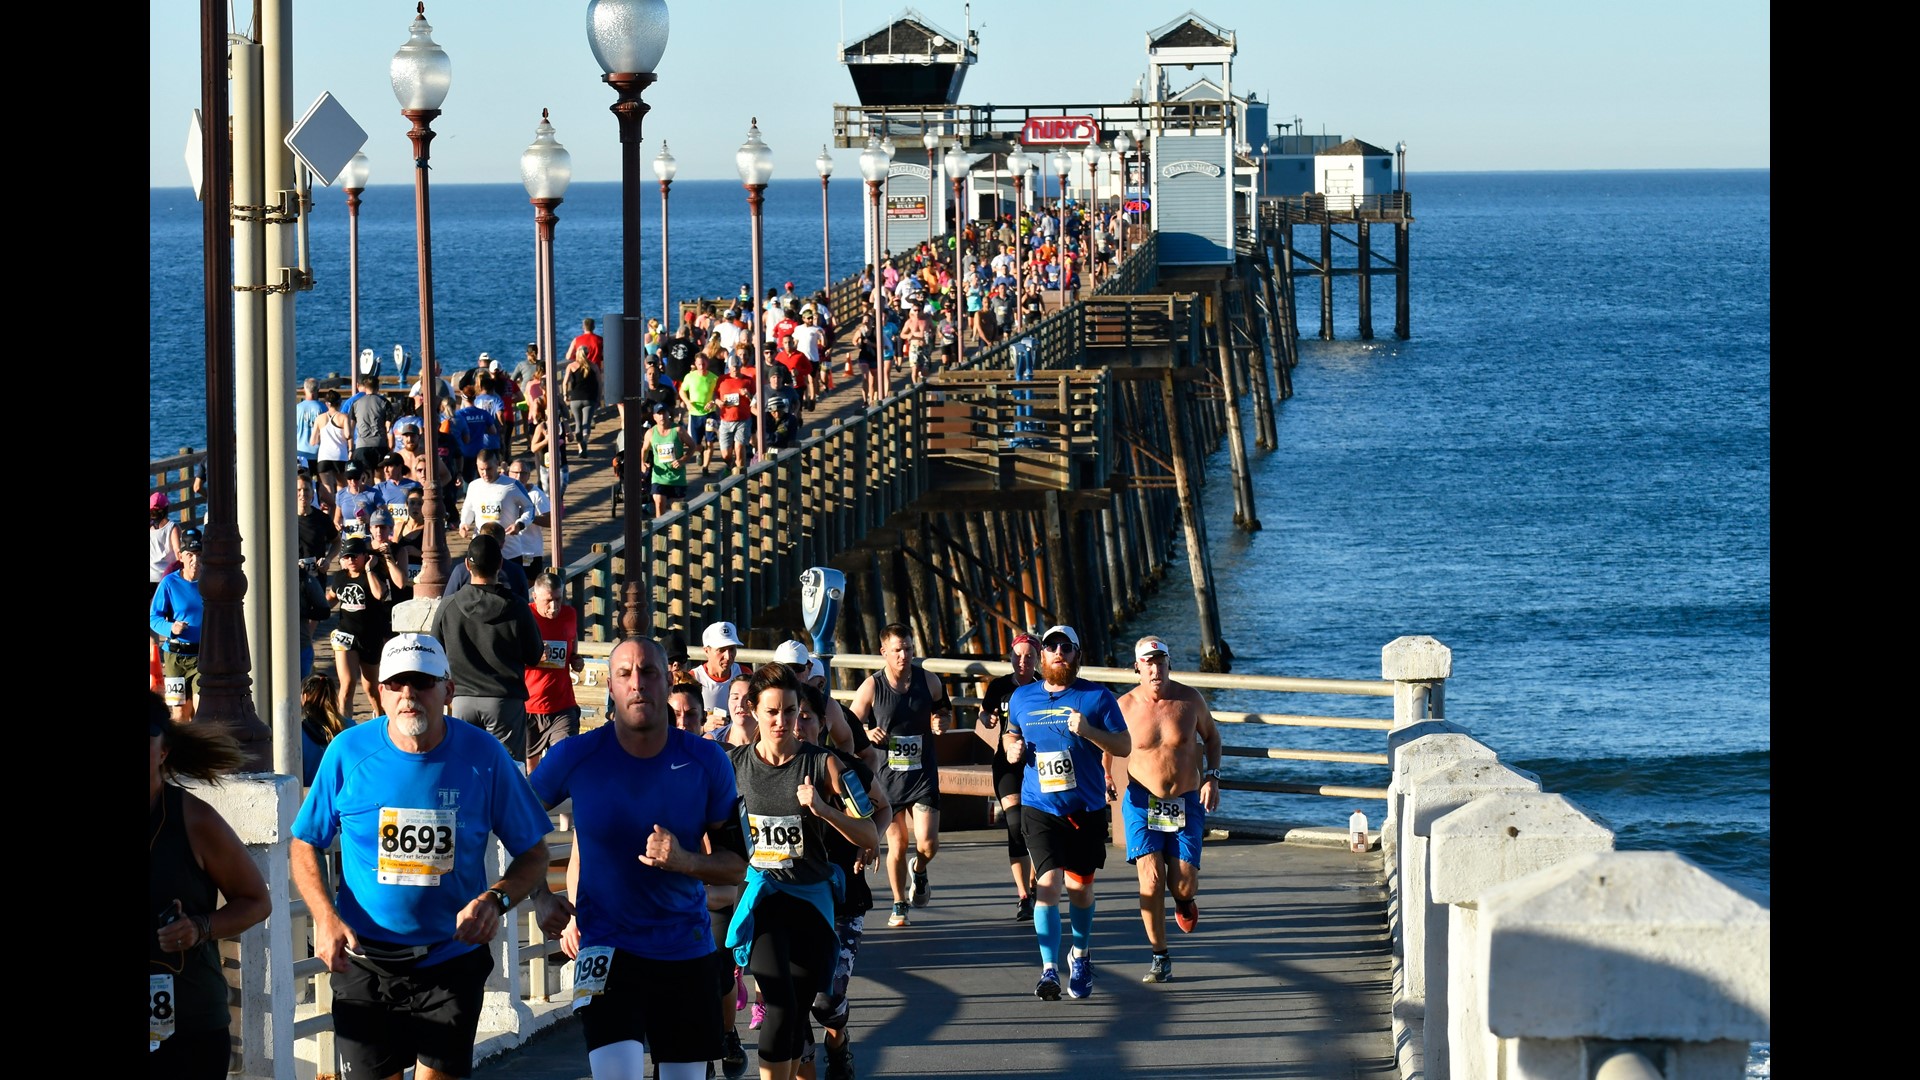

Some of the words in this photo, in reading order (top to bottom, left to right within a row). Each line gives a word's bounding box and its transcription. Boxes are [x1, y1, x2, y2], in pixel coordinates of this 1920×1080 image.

[1031, 120, 1094, 139] RUBY'S
[1168, 163, 1189, 174] BAIT
[1190, 163, 1215, 173] SHOP
[481, 505, 501, 513] 8554
[894, 743, 918, 756] 399
[1038, 758, 1073, 776] 8169
[1154, 802, 1180, 817] 358
[382, 824, 452, 854] 8693
